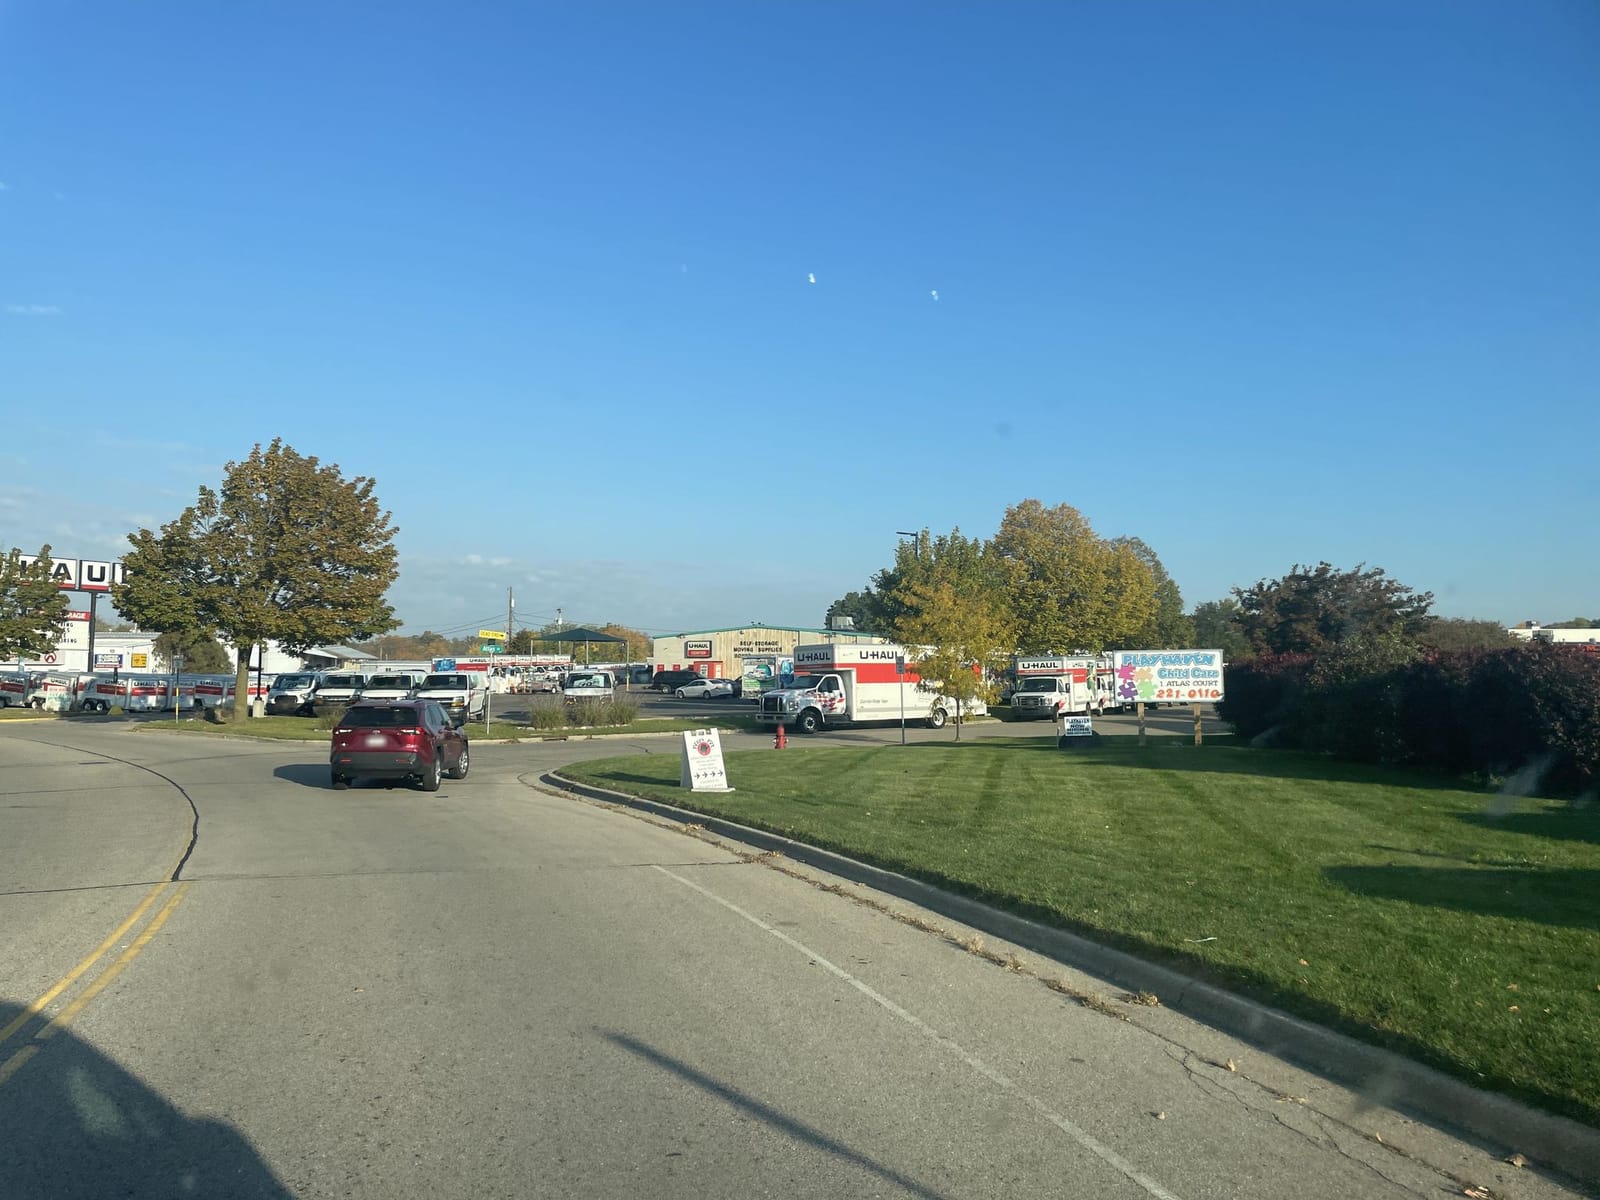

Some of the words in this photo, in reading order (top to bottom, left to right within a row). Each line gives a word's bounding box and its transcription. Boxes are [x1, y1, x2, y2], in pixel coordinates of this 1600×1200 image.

[797, 652, 831, 662] U-HAUL
[1121, 653, 1215, 667] PLAYHAVEN
[1157, 667, 1190, 680] Child
[1190, 667, 1220, 680] Care
[1156, 688, 1220, 699] 221-0110
